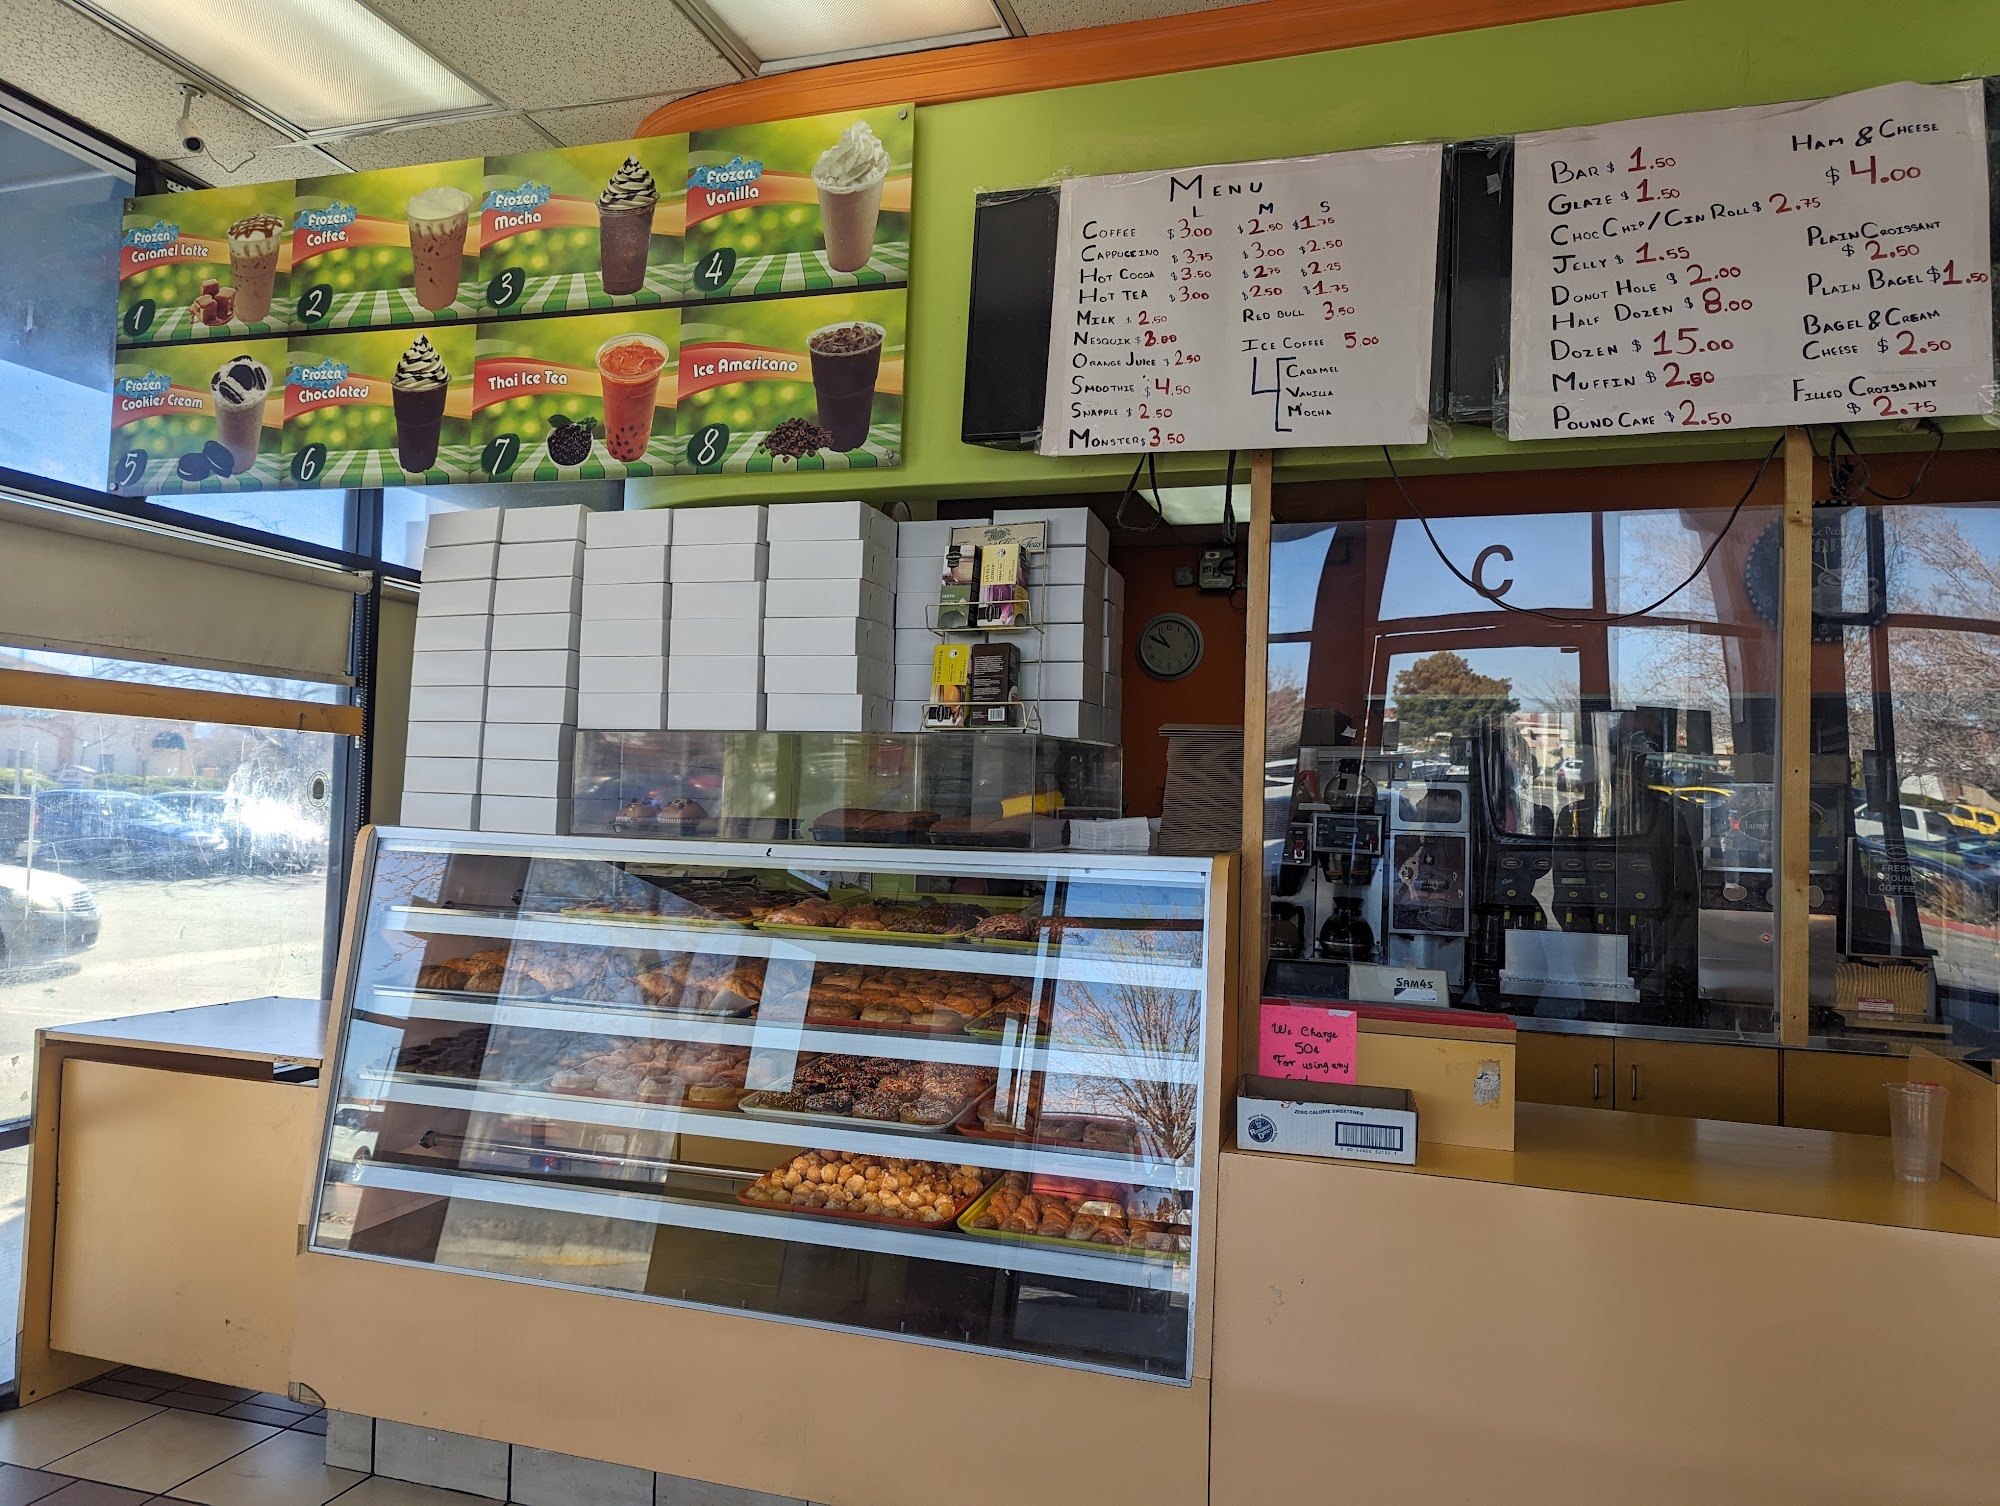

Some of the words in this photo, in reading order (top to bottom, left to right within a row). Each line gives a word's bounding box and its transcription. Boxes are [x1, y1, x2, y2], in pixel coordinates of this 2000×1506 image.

[1791, 134, 1844, 152] HAM
[1854, 126, 1874, 147] &
[1878, 118, 1939, 138] CHEESE
[706, 169, 754, 184] Frozen
[1550, 160, 1600, 184] BAR
[705, 185, 759, 207] Vanilla
[1169, 174, 1264, 202] MENU
[495, 193, 538, 207] Frozen
[1193, 205, 1204, 218] L
[1258, 202, 1274, 215] M
[1320, 201, 1330, 213] S
[1548, 193, 1613, 215] GLAZE
[308, 213, 347, 227] Frozen
[494, 211, 542, 231] Mocha
[1082, 220, 1136, 240] COFFEE
[1550, 224, 1600, 246] CHOC
[1710, 203, 1750, 219] ROLL
[134, 232, 170, 244] Frozen
[1806, 225, 1860, 246] PLAIN
[1860, 221, 1941, 239] CROISSANT
[131, 244, 178, 263] Caramel
[705, 252, 723, 285] 4
[1552, 254, 1607, 274] JELLY
[1079, 268, 1113, 284] HOT
[1119, 268, 1155, 280] COCOA
[1807, 273, 1861, 296] PLAIN
[1867, 268, 1924, 290] BAGEL
[494, 272, 513, 305] 3
[1079, 287, 1115, 304] HOT
[1121, 289, 1149, 301] TEA
[1551, 285, 1608, 306] DONUT
[1616, 279, 1657, 296] HOLE
[305, 289, 323, 317] 2
[1242, 308, 1271, 323] RED
[1277, 309, 1305, 319] BULL
[1322, 300, 1355, 321] 3.50
[133, 305, 145, 330] 1
[1076, 310, 1116, 326] MILK
[1552, 312, 1600, 331] HALF
[1614, 303, 1673, 322] DOZEN
[1802, 313, 1864, 335] BAGEL
[1868, 309, 1881, 331] &
[1884, 307, 1940, 326] CREAM
[1073, 331, 1131, 346] NESQUIK
[1241, 338, 1276, 352] ICE
[1283, 337, 1324, 349] COFFEE
[1343, 331, 1380, 349] 5.00
[1072, 352, 1122, 369] ORANGE
[1125, 351, 1157, 367] JUICE
[1550, 339, 1618, 361] DOZEN
[1802, 340, 1859, 360] CHEESE
[301, 368, 341, 381] Frozen
[693, 363, 715, 378] Ice
[718, 355, 799, 374] Americano
[1286, 364, 1339, 378] CARAMEL
[125, 379, 161, 392] Frozen
[487, 373, 518, 391] Thai
[521, 371, 541, 386] Ice
[544, 370, 568, 385] Tea
[1070, 375, 1135, 395] SMOOTHIE
[1552, 371, 1636, 392] MUFFIN
[1792, 378, 1843, 402] FILLED
[1848, 375, 1937, 397] CROISSANT
[121, 394, 165, 411] Cookies
[167, 393, 203, 409] Cream
[298, 385, 370, 404] Chocolated
[1285, 386, 1334, 398] VANILLA
[1070, 402, 1119, 419] SNAPPLE
[1287, 404, 1332, 417] MOCHA
[1553, 404, 1614, 431] POUND
[1618, 412, 1655, 428] CAKE
[697, 428, 720, 465] 8
[1068, 428, 1139, 449] MONSTER
[300, 447, 316, 481] 6
[491, 437, 510, 476] 7
[120, 452, 138, 486] 5
[1471, 543, 1515, 598] C
[1745, 820, 1770, 830] Farmer
[1881, 864, 1912, 872] FRESH
[1877, 874, 1917, 883] ROUND
[1878, 884, 1916, 893] COFFEE
[1271, 1023, 1293, 1035] We
[1300, 1026, 1338, 1043] Charge
[1273, 1054, 1296, 1067] For
[1302, 1061, 1329, 1074] using
[1331, 1062, 1349, 1074] any
[1332, 1109, 1364, 1117] SWEETENER
